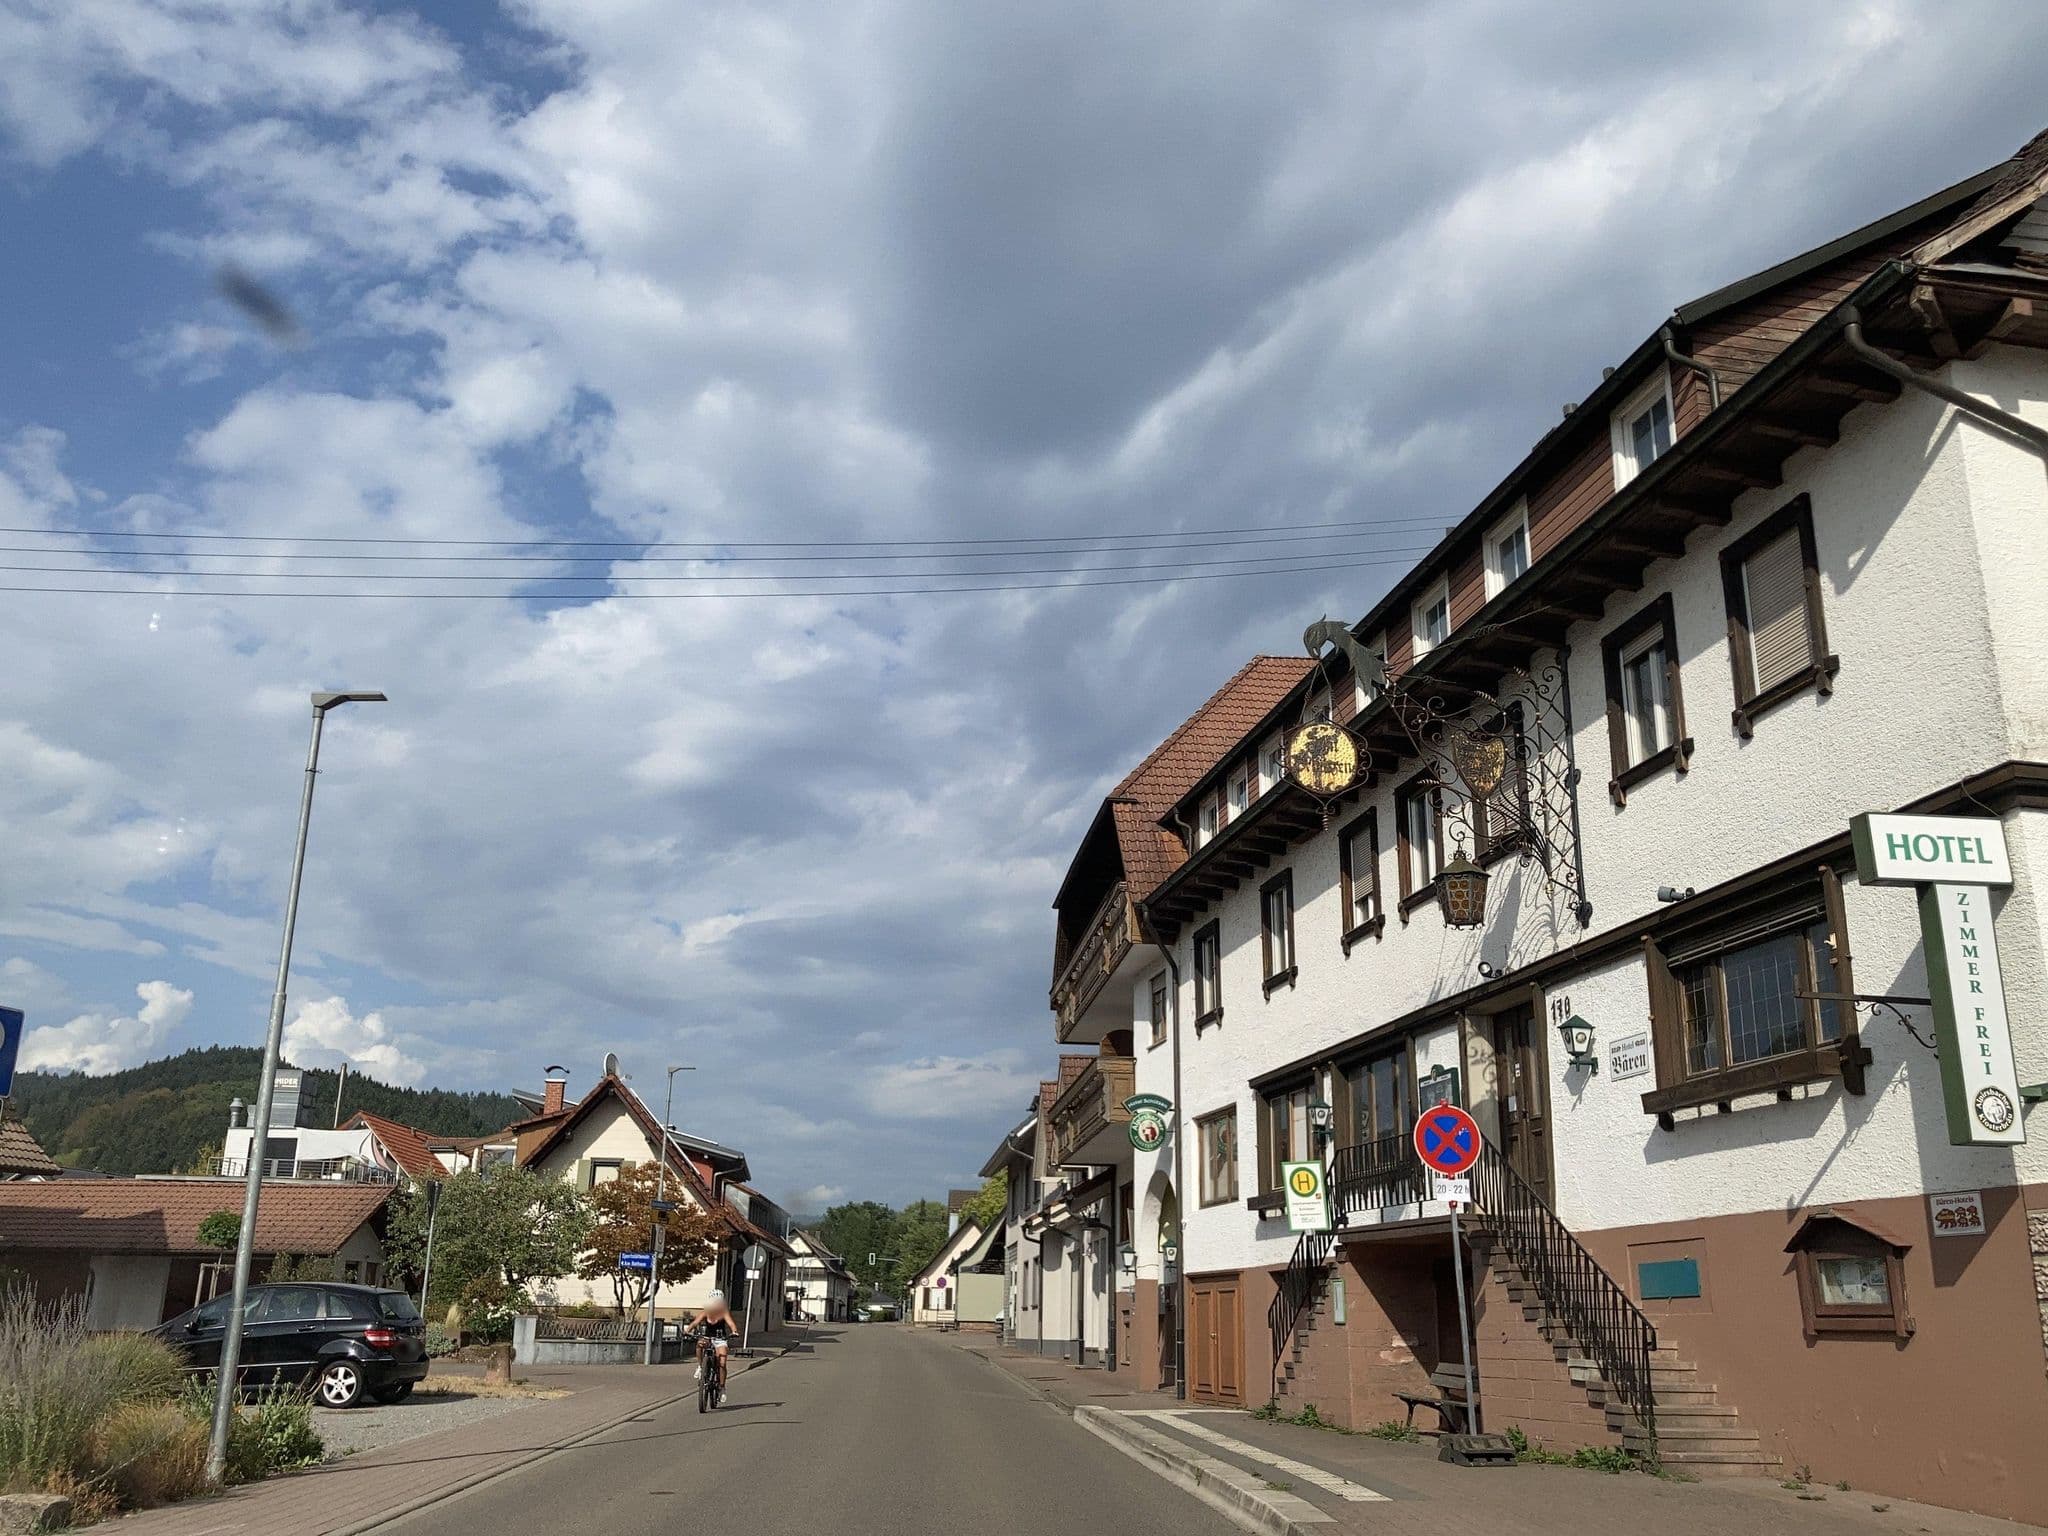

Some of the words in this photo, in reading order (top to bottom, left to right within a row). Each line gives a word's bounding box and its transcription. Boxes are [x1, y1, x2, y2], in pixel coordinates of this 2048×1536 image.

[1886, 833, 1993, 865] HOTEL
[1957, 892, 1983, 994] ZIMMER
[1974, 1007, 1992, 1075] FREI
[1612, 1054, 1646, 1074] Bären
[1297, 1173, 1311, 1191] H
[1437, 1184, 1447, 1194] 20
[1453, 1184, 1463, 1194] 22
